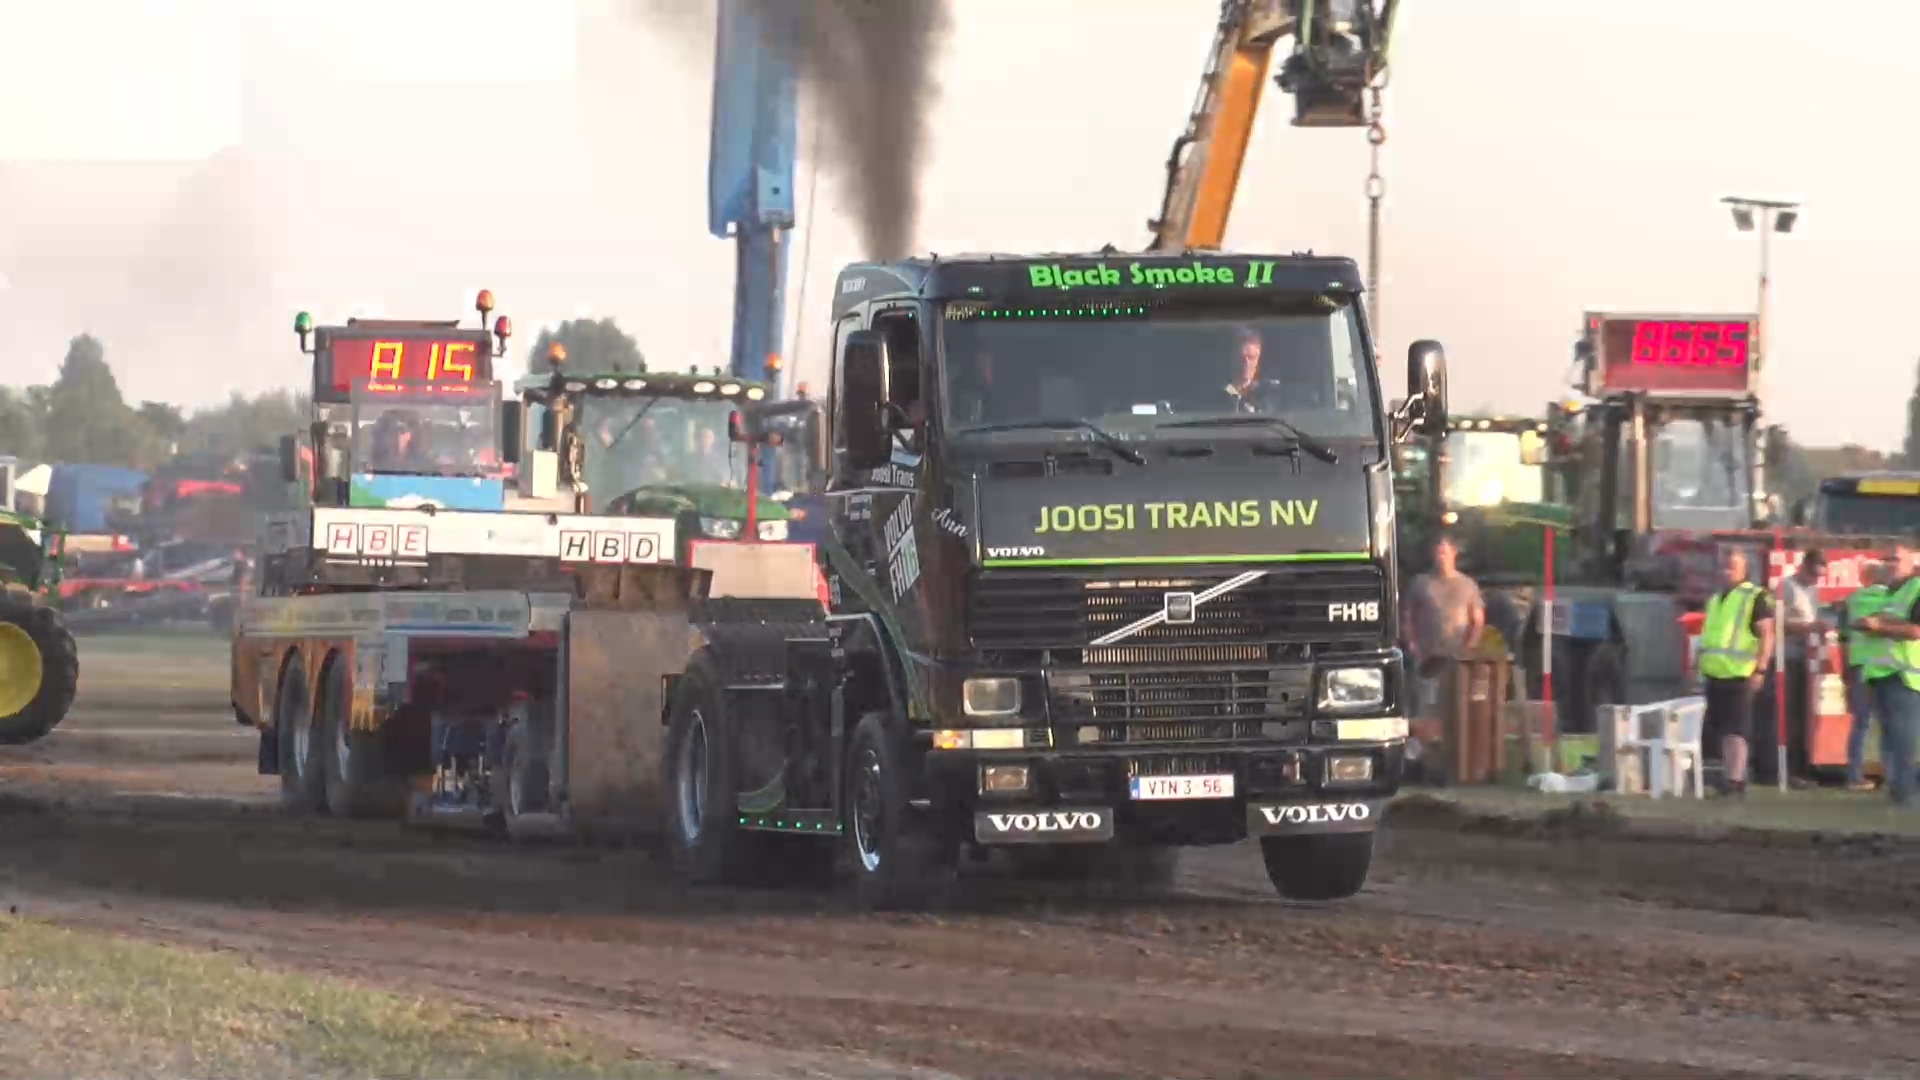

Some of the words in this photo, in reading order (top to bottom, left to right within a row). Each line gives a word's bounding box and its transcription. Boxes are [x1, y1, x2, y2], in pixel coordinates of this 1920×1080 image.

[1029, 261, 1120, 287] Black
[1129, 262, 1234, 285] Smoke
[1246, 260, 1276, 285] II
[883, 494, 912, 552] VOLVO
[1034, 503, 1135, 534] JOOSI
[1143, 501, 1261, 529] TRANS
[1269, 499, 1318, 527] NV
[987, 546, 1046, 558] VOLVO
[987, 811, 1101, 832] VOLVO
[1259, 802, 1370, 825] VOLVO
